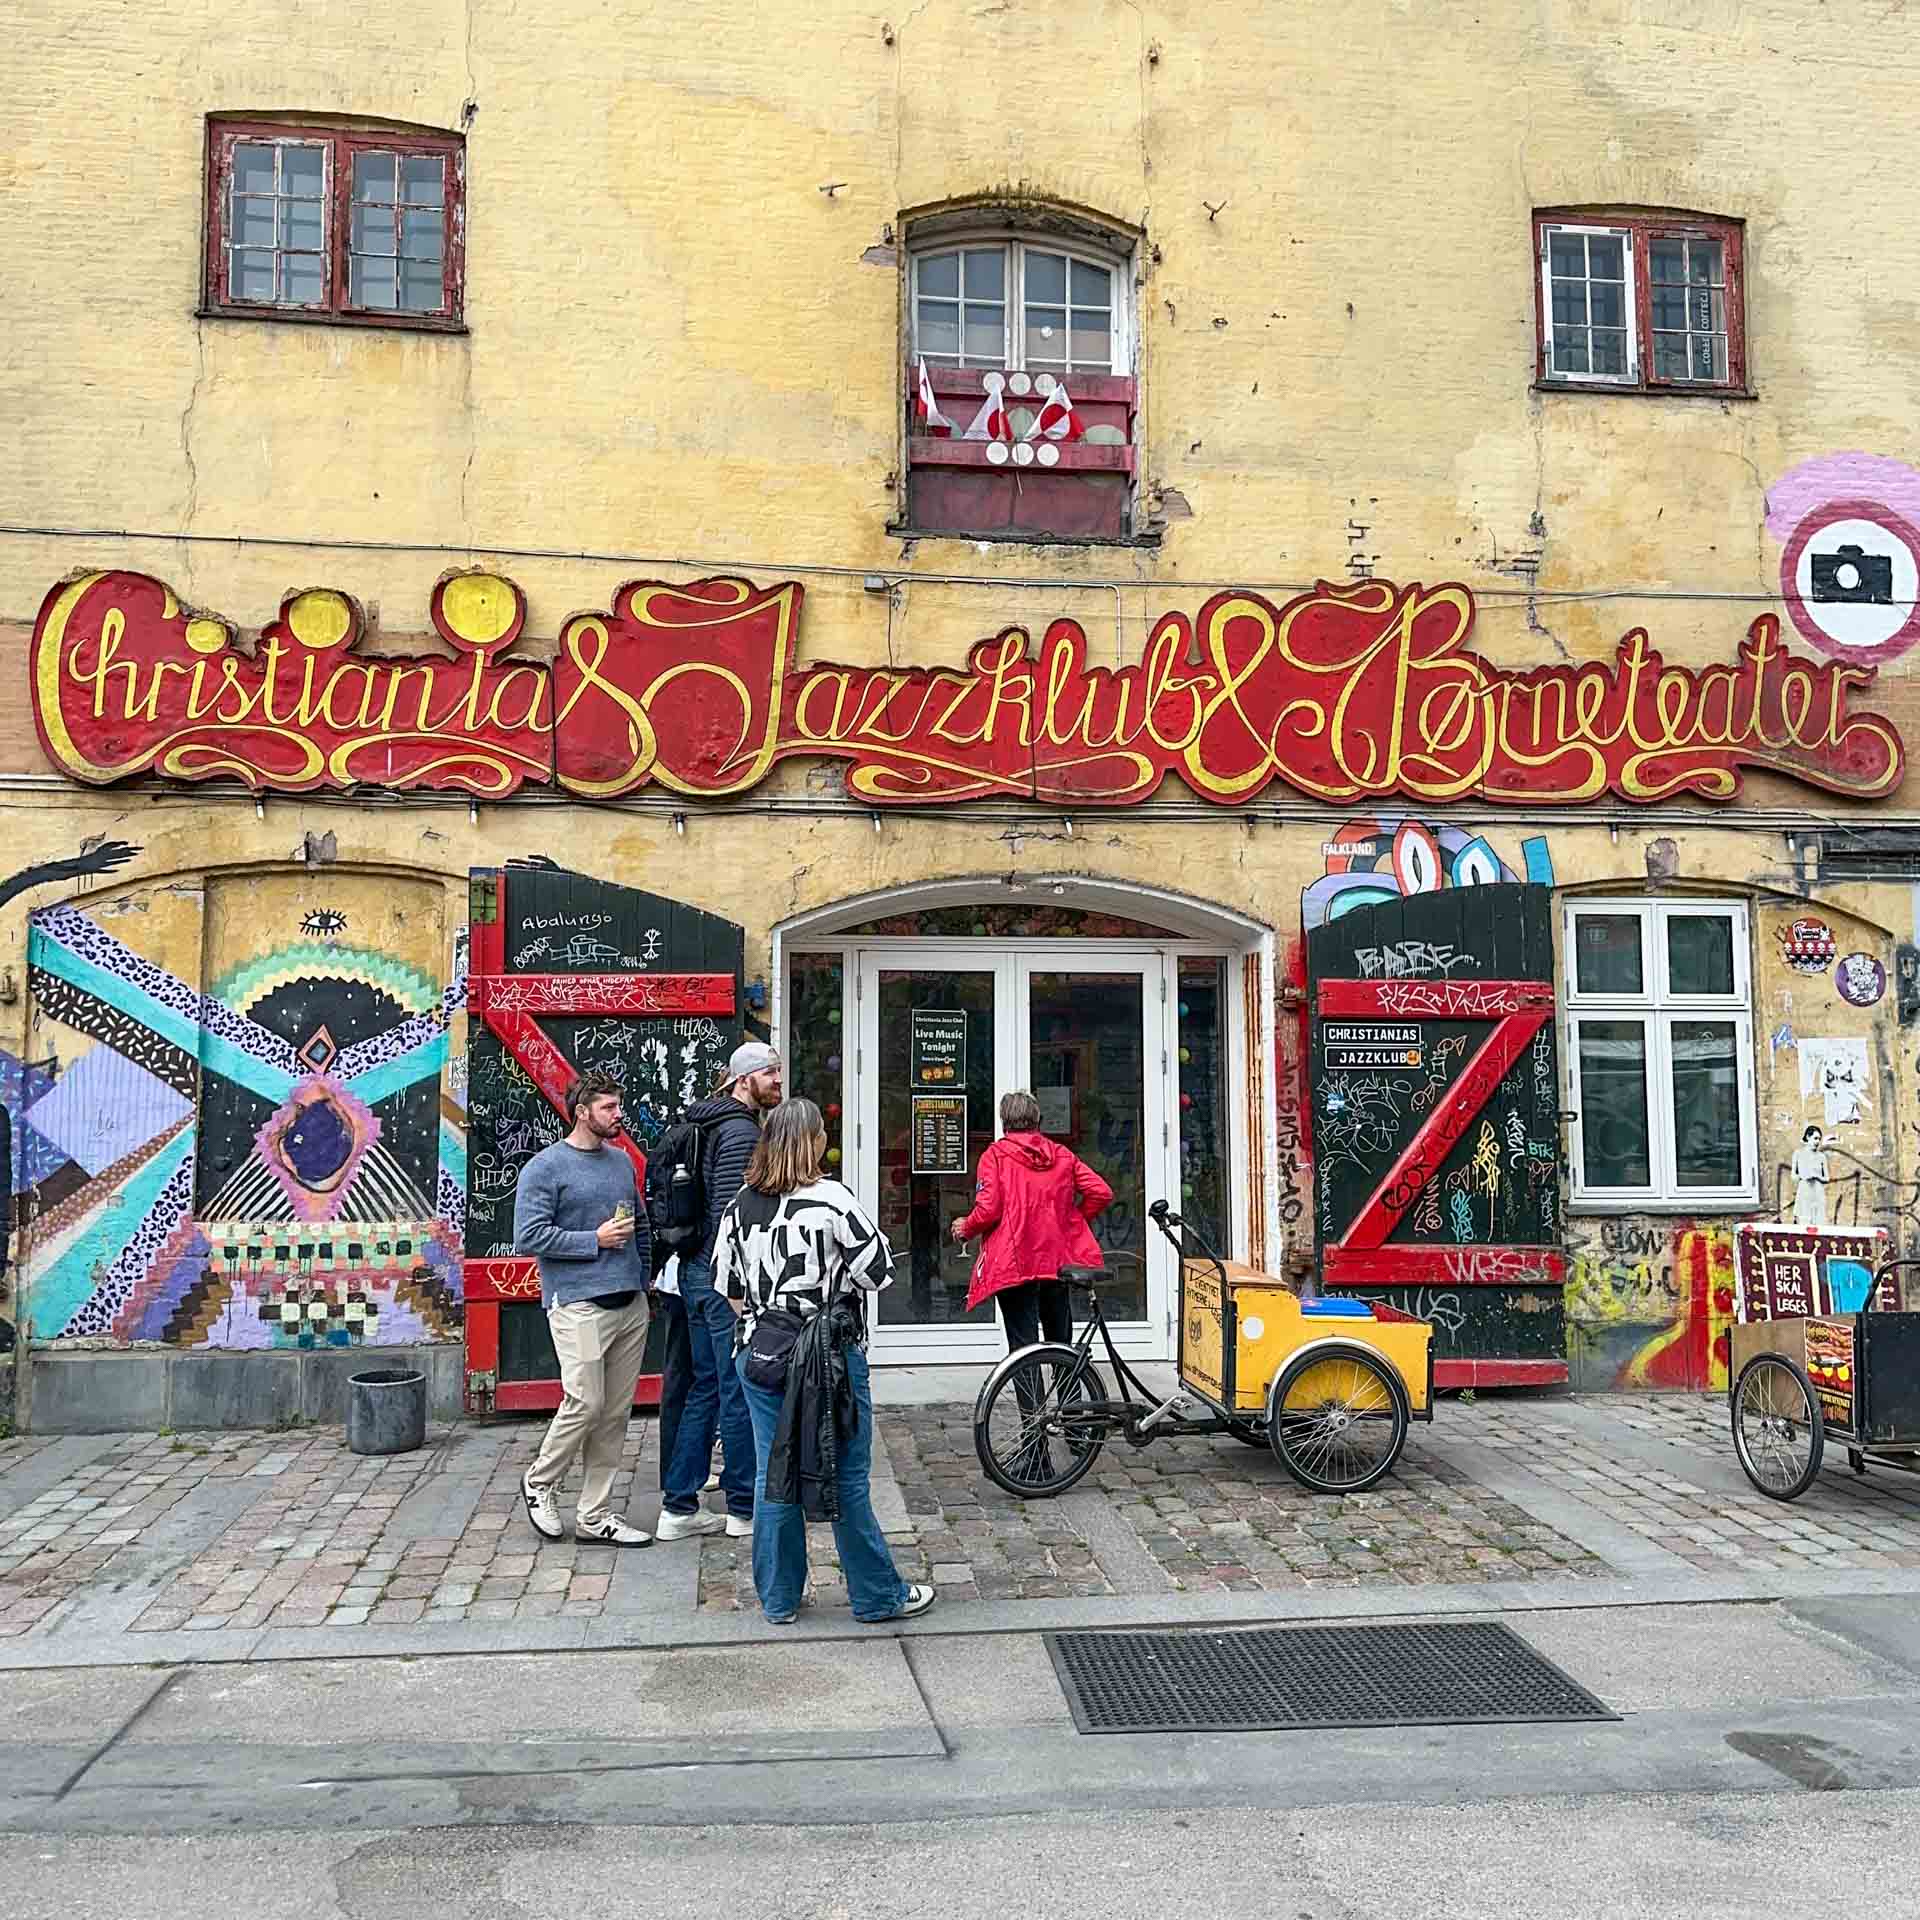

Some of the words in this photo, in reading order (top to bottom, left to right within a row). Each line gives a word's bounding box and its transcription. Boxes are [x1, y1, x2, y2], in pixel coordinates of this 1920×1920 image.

[628, 582, 1216, 797] Jazzklub
[1185, 598, 1345, 796] &
[1322, 842, 1373, 856] FALKLAND
[915, 1029, 934, 1039] Live
[935, 1029, 963, 1040] Music
[1328, 1028, 1417, 1041] CHRISTIANIAS
[921, 1041, 956, 1053] Tonight
[1339, 1052, 1408, 1064] JAZZKLUB
[1775, 1264, 1802, 1281] HER
[1775, 1280, 1805, 1296] SKAL
[1776, 1297, 1808, 1314] LEGES
[600, 1525, 618, 1538] N
